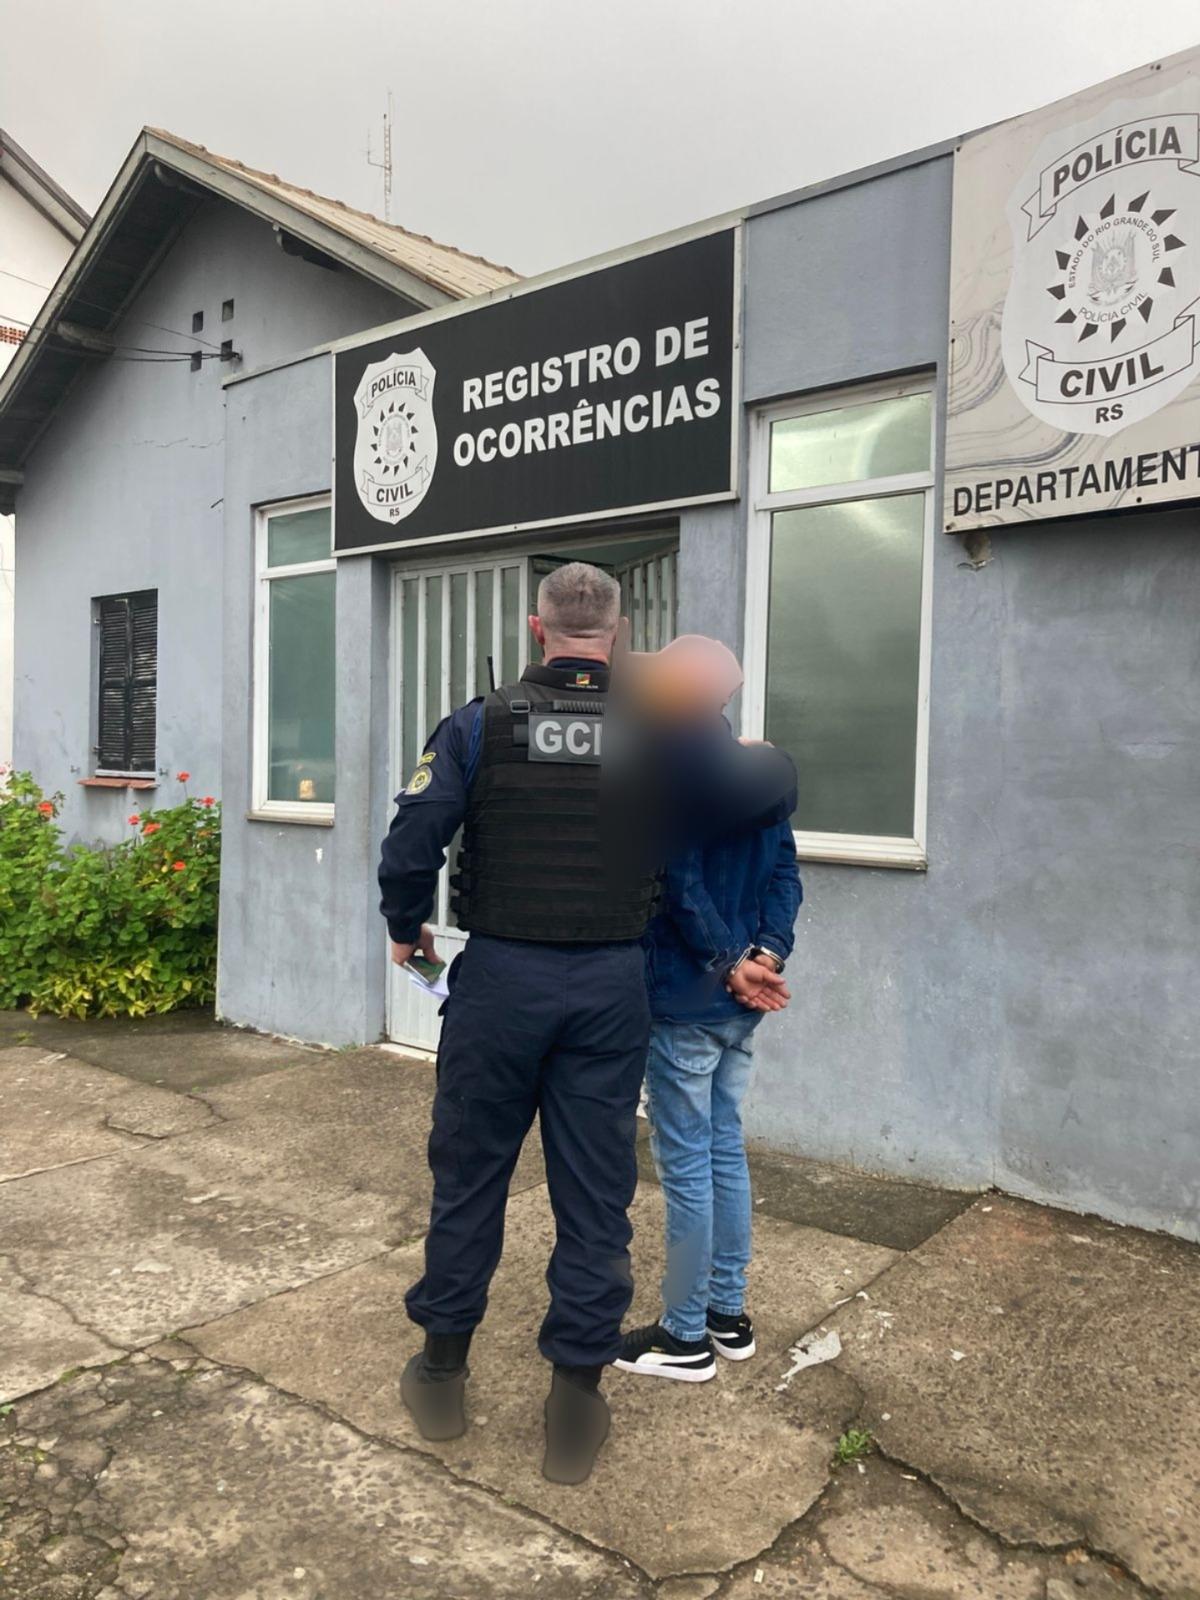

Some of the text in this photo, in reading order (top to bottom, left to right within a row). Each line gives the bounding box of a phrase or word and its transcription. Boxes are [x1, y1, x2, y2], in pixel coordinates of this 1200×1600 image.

[1053, 126, 1182, 198] POLÍCIA
[1068, 217, 1160, 288] ESTADO DO RIO GRANDE DO SUL
[1120, 292, 1148, 315] CIVIL
[462, 316, 709, 413] REGISTRO DE
[1060, 352, 1164, 398] CIVIL
[453, 377, 721, 468] OCORRÊNCIAS
[1095, 403, 1124, 424] RS
[376, 483, 413, 503] CIVIL
[389, 507, 400, 518] RS
